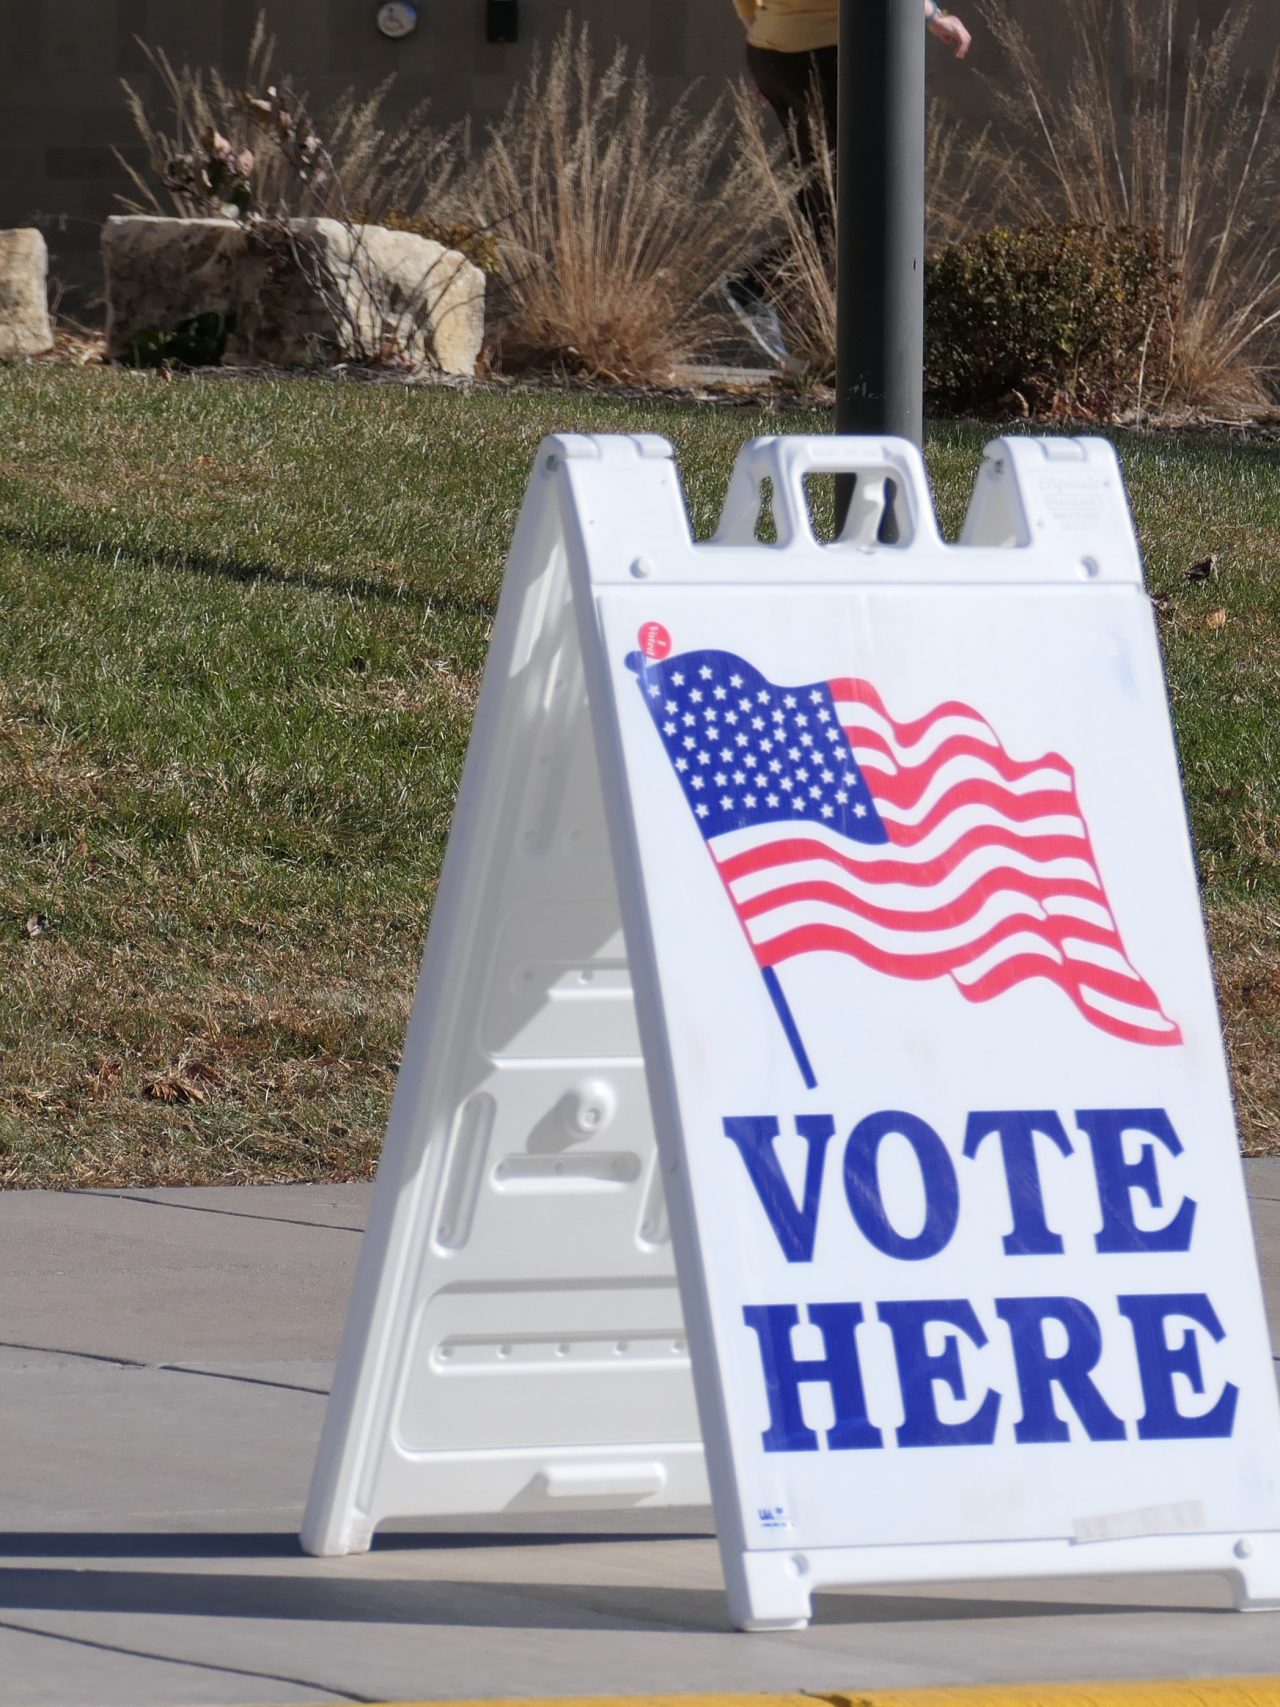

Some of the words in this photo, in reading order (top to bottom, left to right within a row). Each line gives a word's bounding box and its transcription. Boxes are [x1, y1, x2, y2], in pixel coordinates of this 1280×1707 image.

[646, 625, 659, 656] Voted
[722, 1108, 1197, 1263] VOTE
[742, 1293, 1240, 1453] HERE
